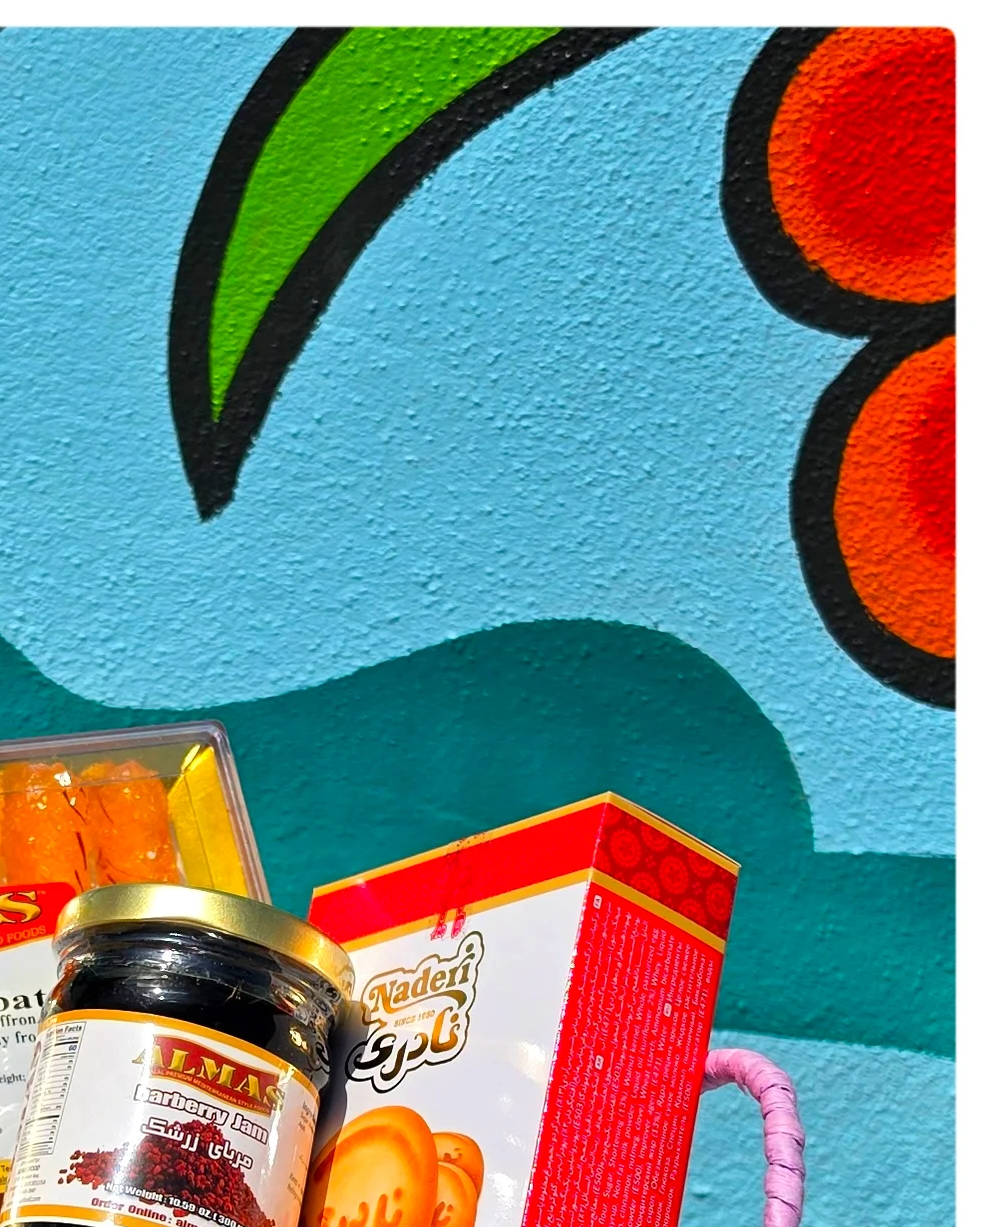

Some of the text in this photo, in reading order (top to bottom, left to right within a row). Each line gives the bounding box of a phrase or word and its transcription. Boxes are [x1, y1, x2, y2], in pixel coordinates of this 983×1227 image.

[7, 926, 46, 942] FOODS
[369, 942, 475, 1014] Naderi
[15, 1031, 37, 1043] fro
[353, 1007, 461, 1081] نادری
[132, 1044, 286, 1111] ALMAS
[141, 1117, 254, 1170] مربای زرشک
[231, 1113, 268, 1145] Jam
